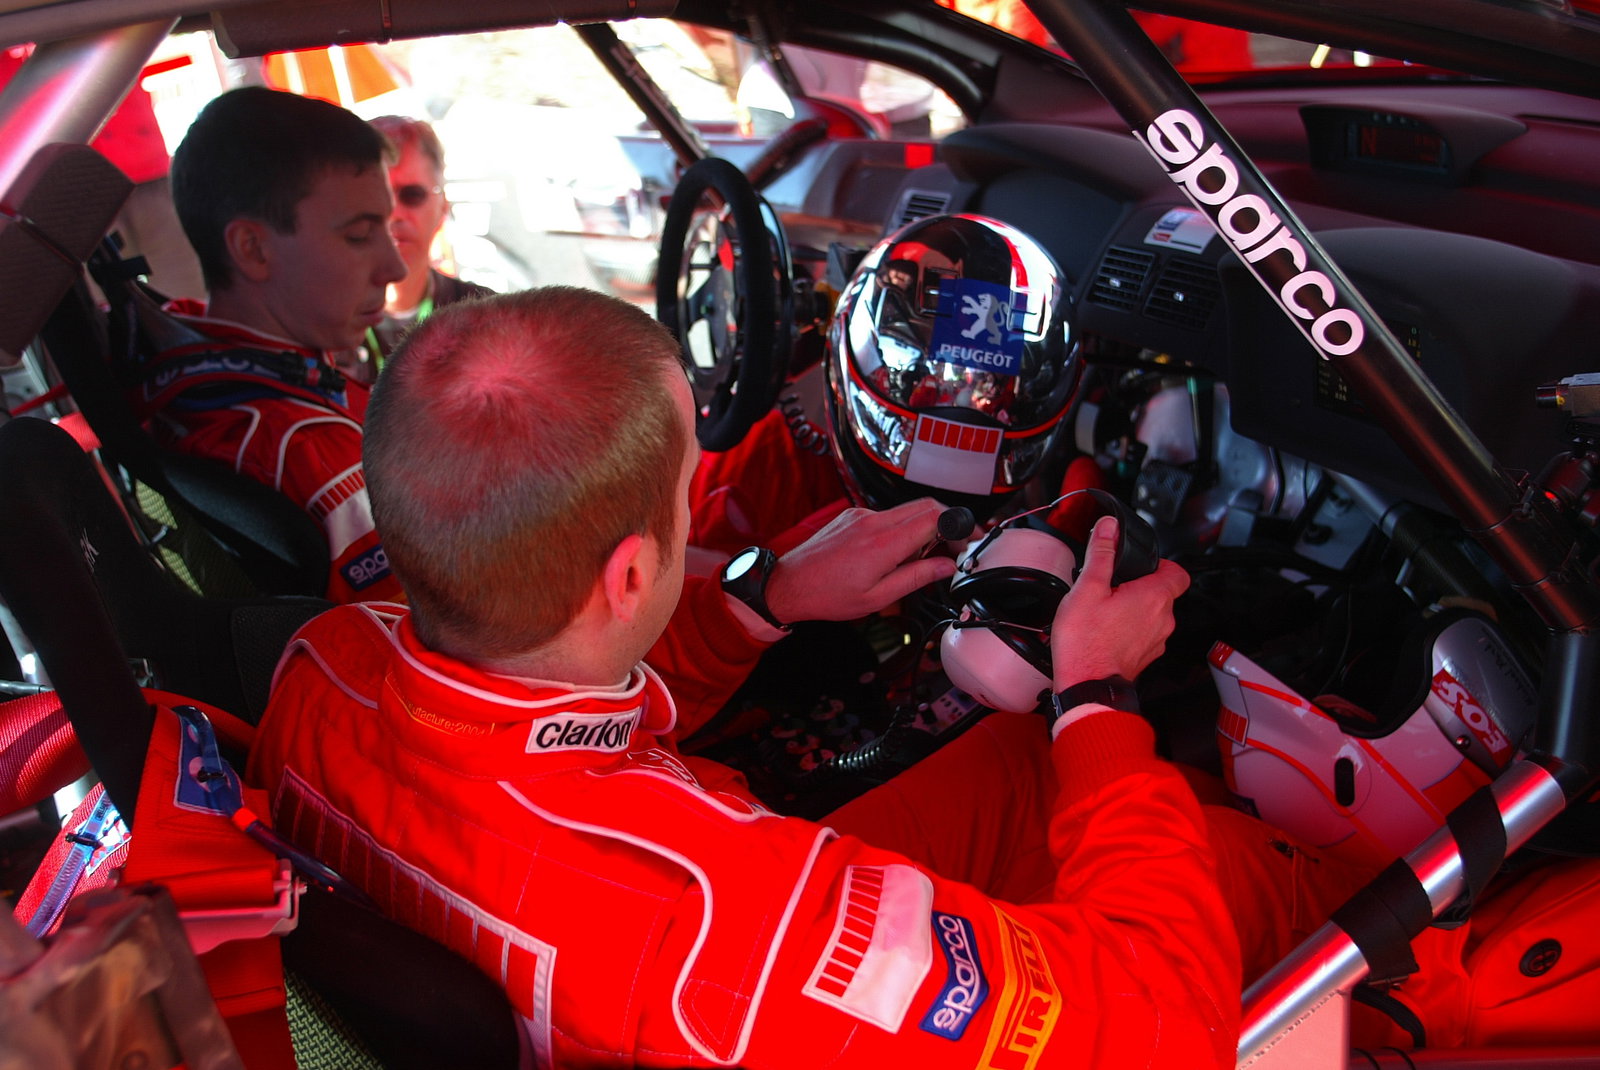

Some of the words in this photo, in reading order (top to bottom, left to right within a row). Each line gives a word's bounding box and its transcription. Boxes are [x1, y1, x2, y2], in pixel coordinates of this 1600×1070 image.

[1146, 109, 1365, 357] sparco
[940, 343, 1013, 368] PEUGEOT
[348, 550, 390, 584] spa
[932, 914, 981, 1032] sparco
